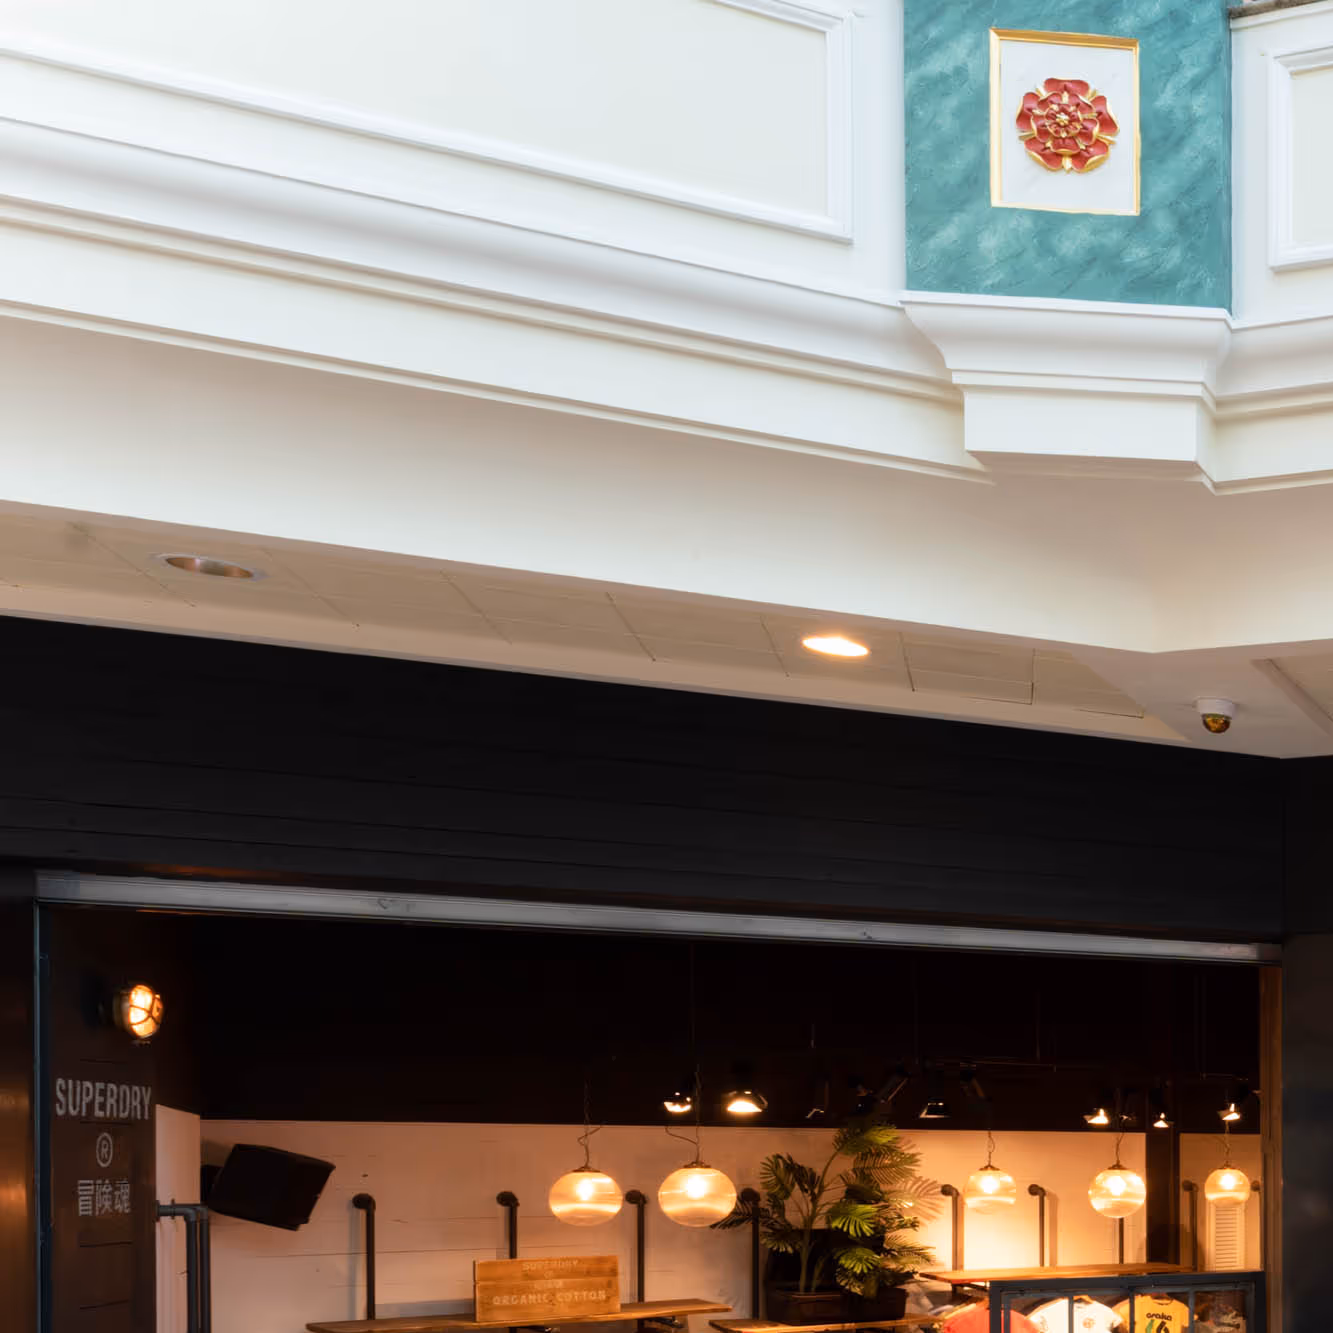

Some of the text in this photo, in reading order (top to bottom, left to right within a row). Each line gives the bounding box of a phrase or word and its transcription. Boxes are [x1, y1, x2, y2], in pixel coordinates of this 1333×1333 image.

[55, 1077, 152, 1120] SUPERDRY
[77, 1179, 131, 1216] 冒険魂
[493, 1289, 607, 1305] ORGANIC COTTON
